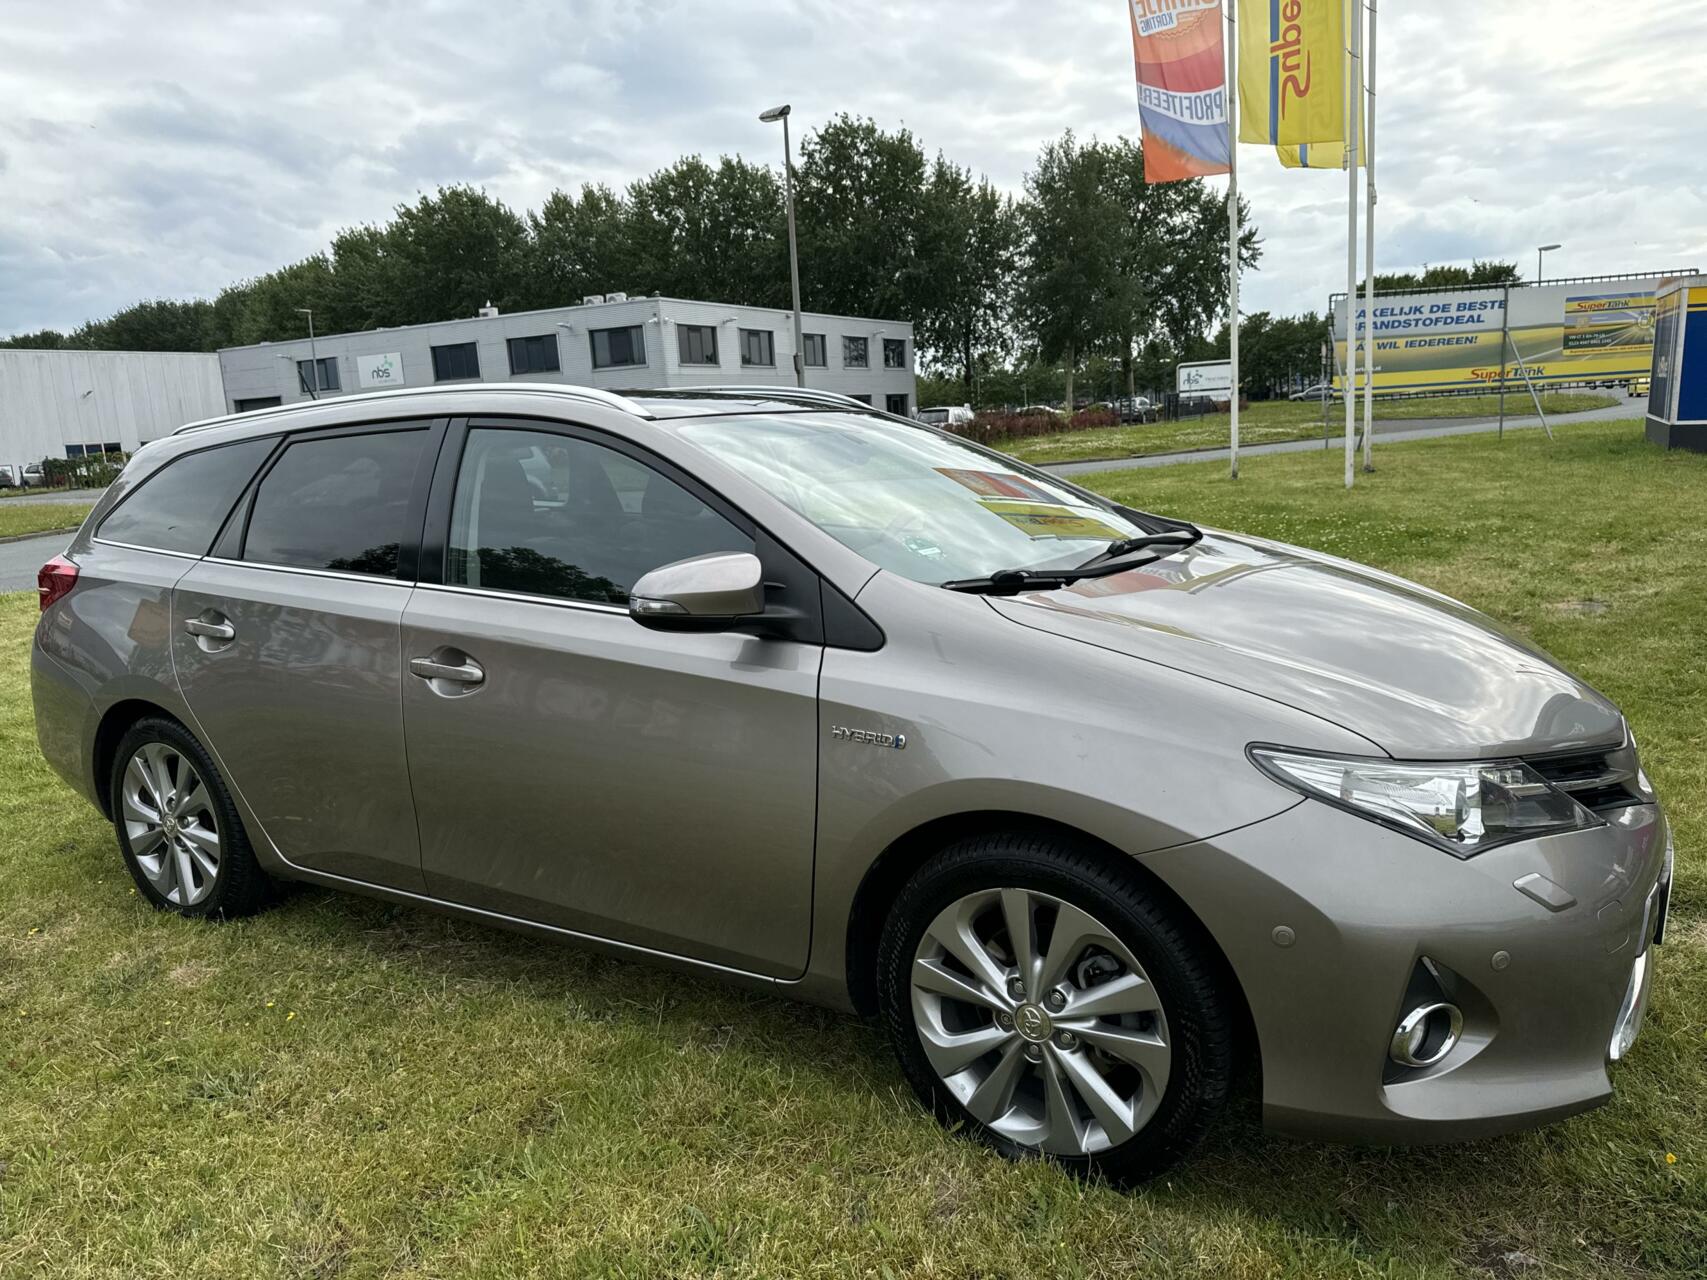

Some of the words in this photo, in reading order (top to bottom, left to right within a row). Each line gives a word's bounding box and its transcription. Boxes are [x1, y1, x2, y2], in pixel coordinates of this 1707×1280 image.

[1355, 303, 1424, 320] AKELIJK
[1429, 303, 1452, 315] DE
[1456, 299, 1505, 313] BESTE
[1355, 313, 1485, 333] RANDSTOFDEAL
[1376, 340, 1401, 351] WIL
[1405, 335, 1478, 349] IEDEREEN!
[371, 365, 391, 380] nbs
[1182, 371, 1200, 385] nbs
[831, 725, 894, 748] HYBRID
